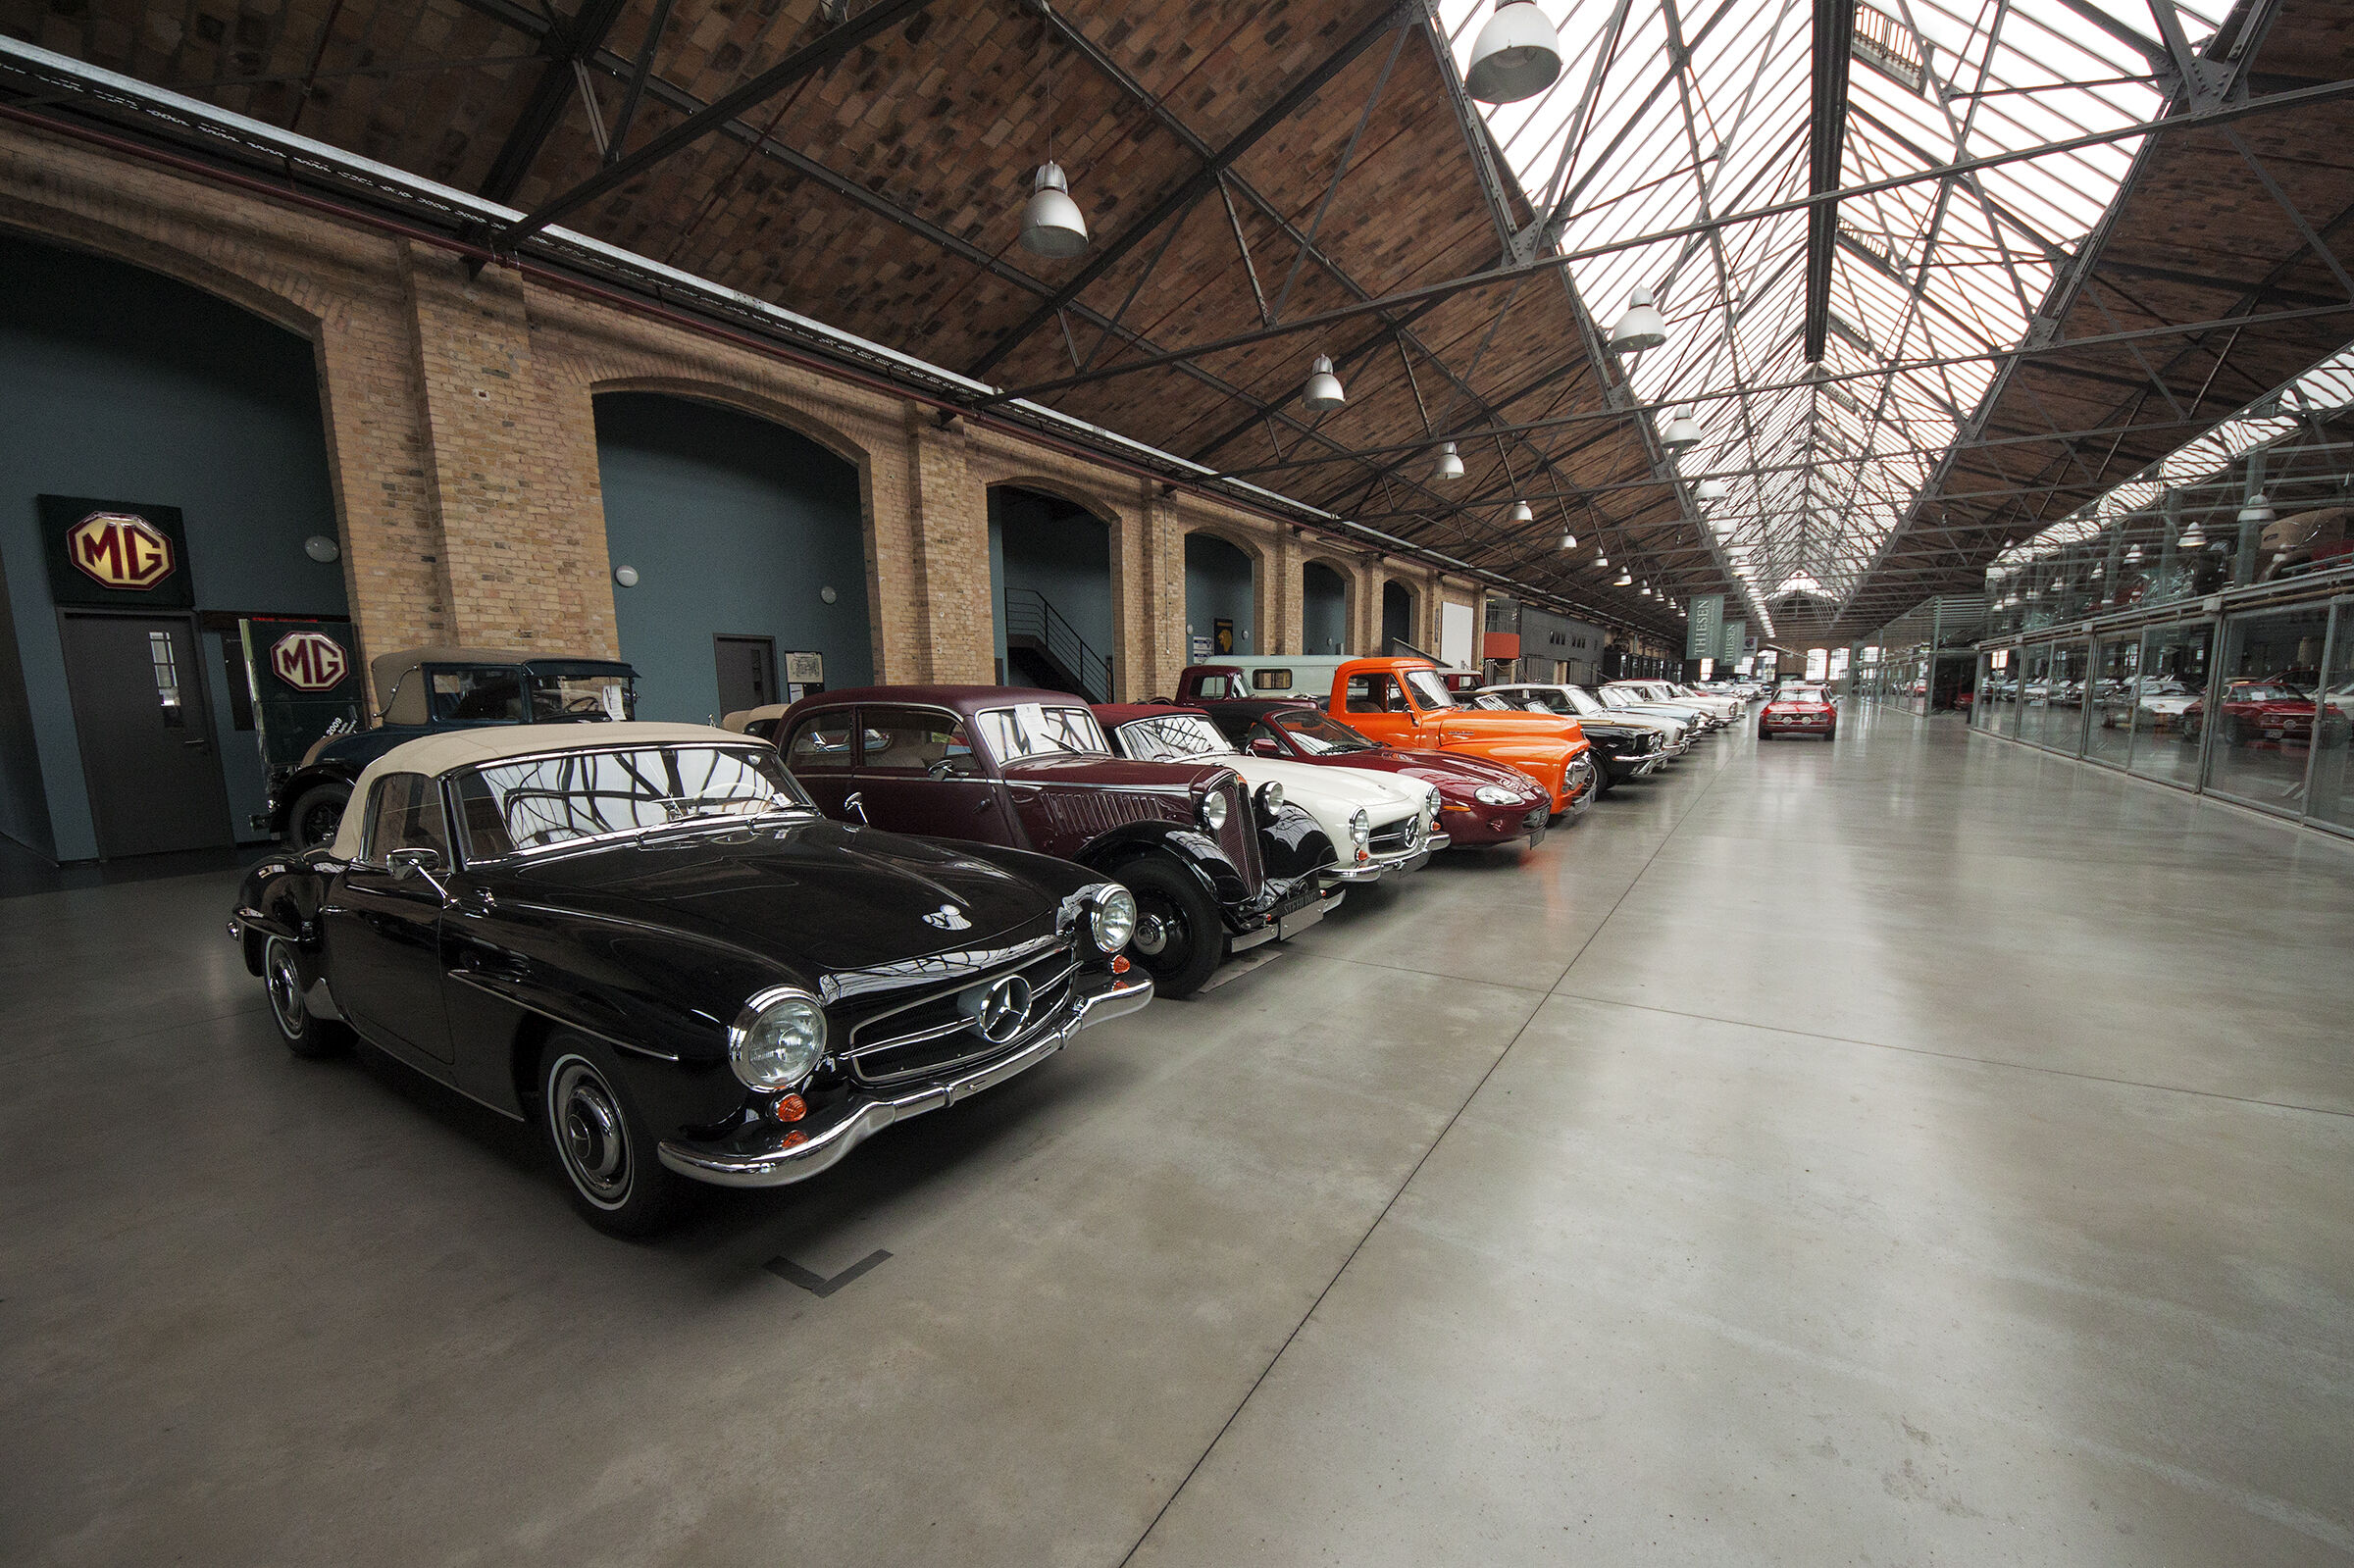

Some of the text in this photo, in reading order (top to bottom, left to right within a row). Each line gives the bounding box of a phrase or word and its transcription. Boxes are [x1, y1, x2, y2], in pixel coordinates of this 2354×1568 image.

[82, 523, 163, 581] MG
[1695, 600, 1709, 655] THIESEN
[1725, 624, 1735, 663] THIESEN
[281, 638, 340, 684] MG
[326, 717, 342, 735] 2009
